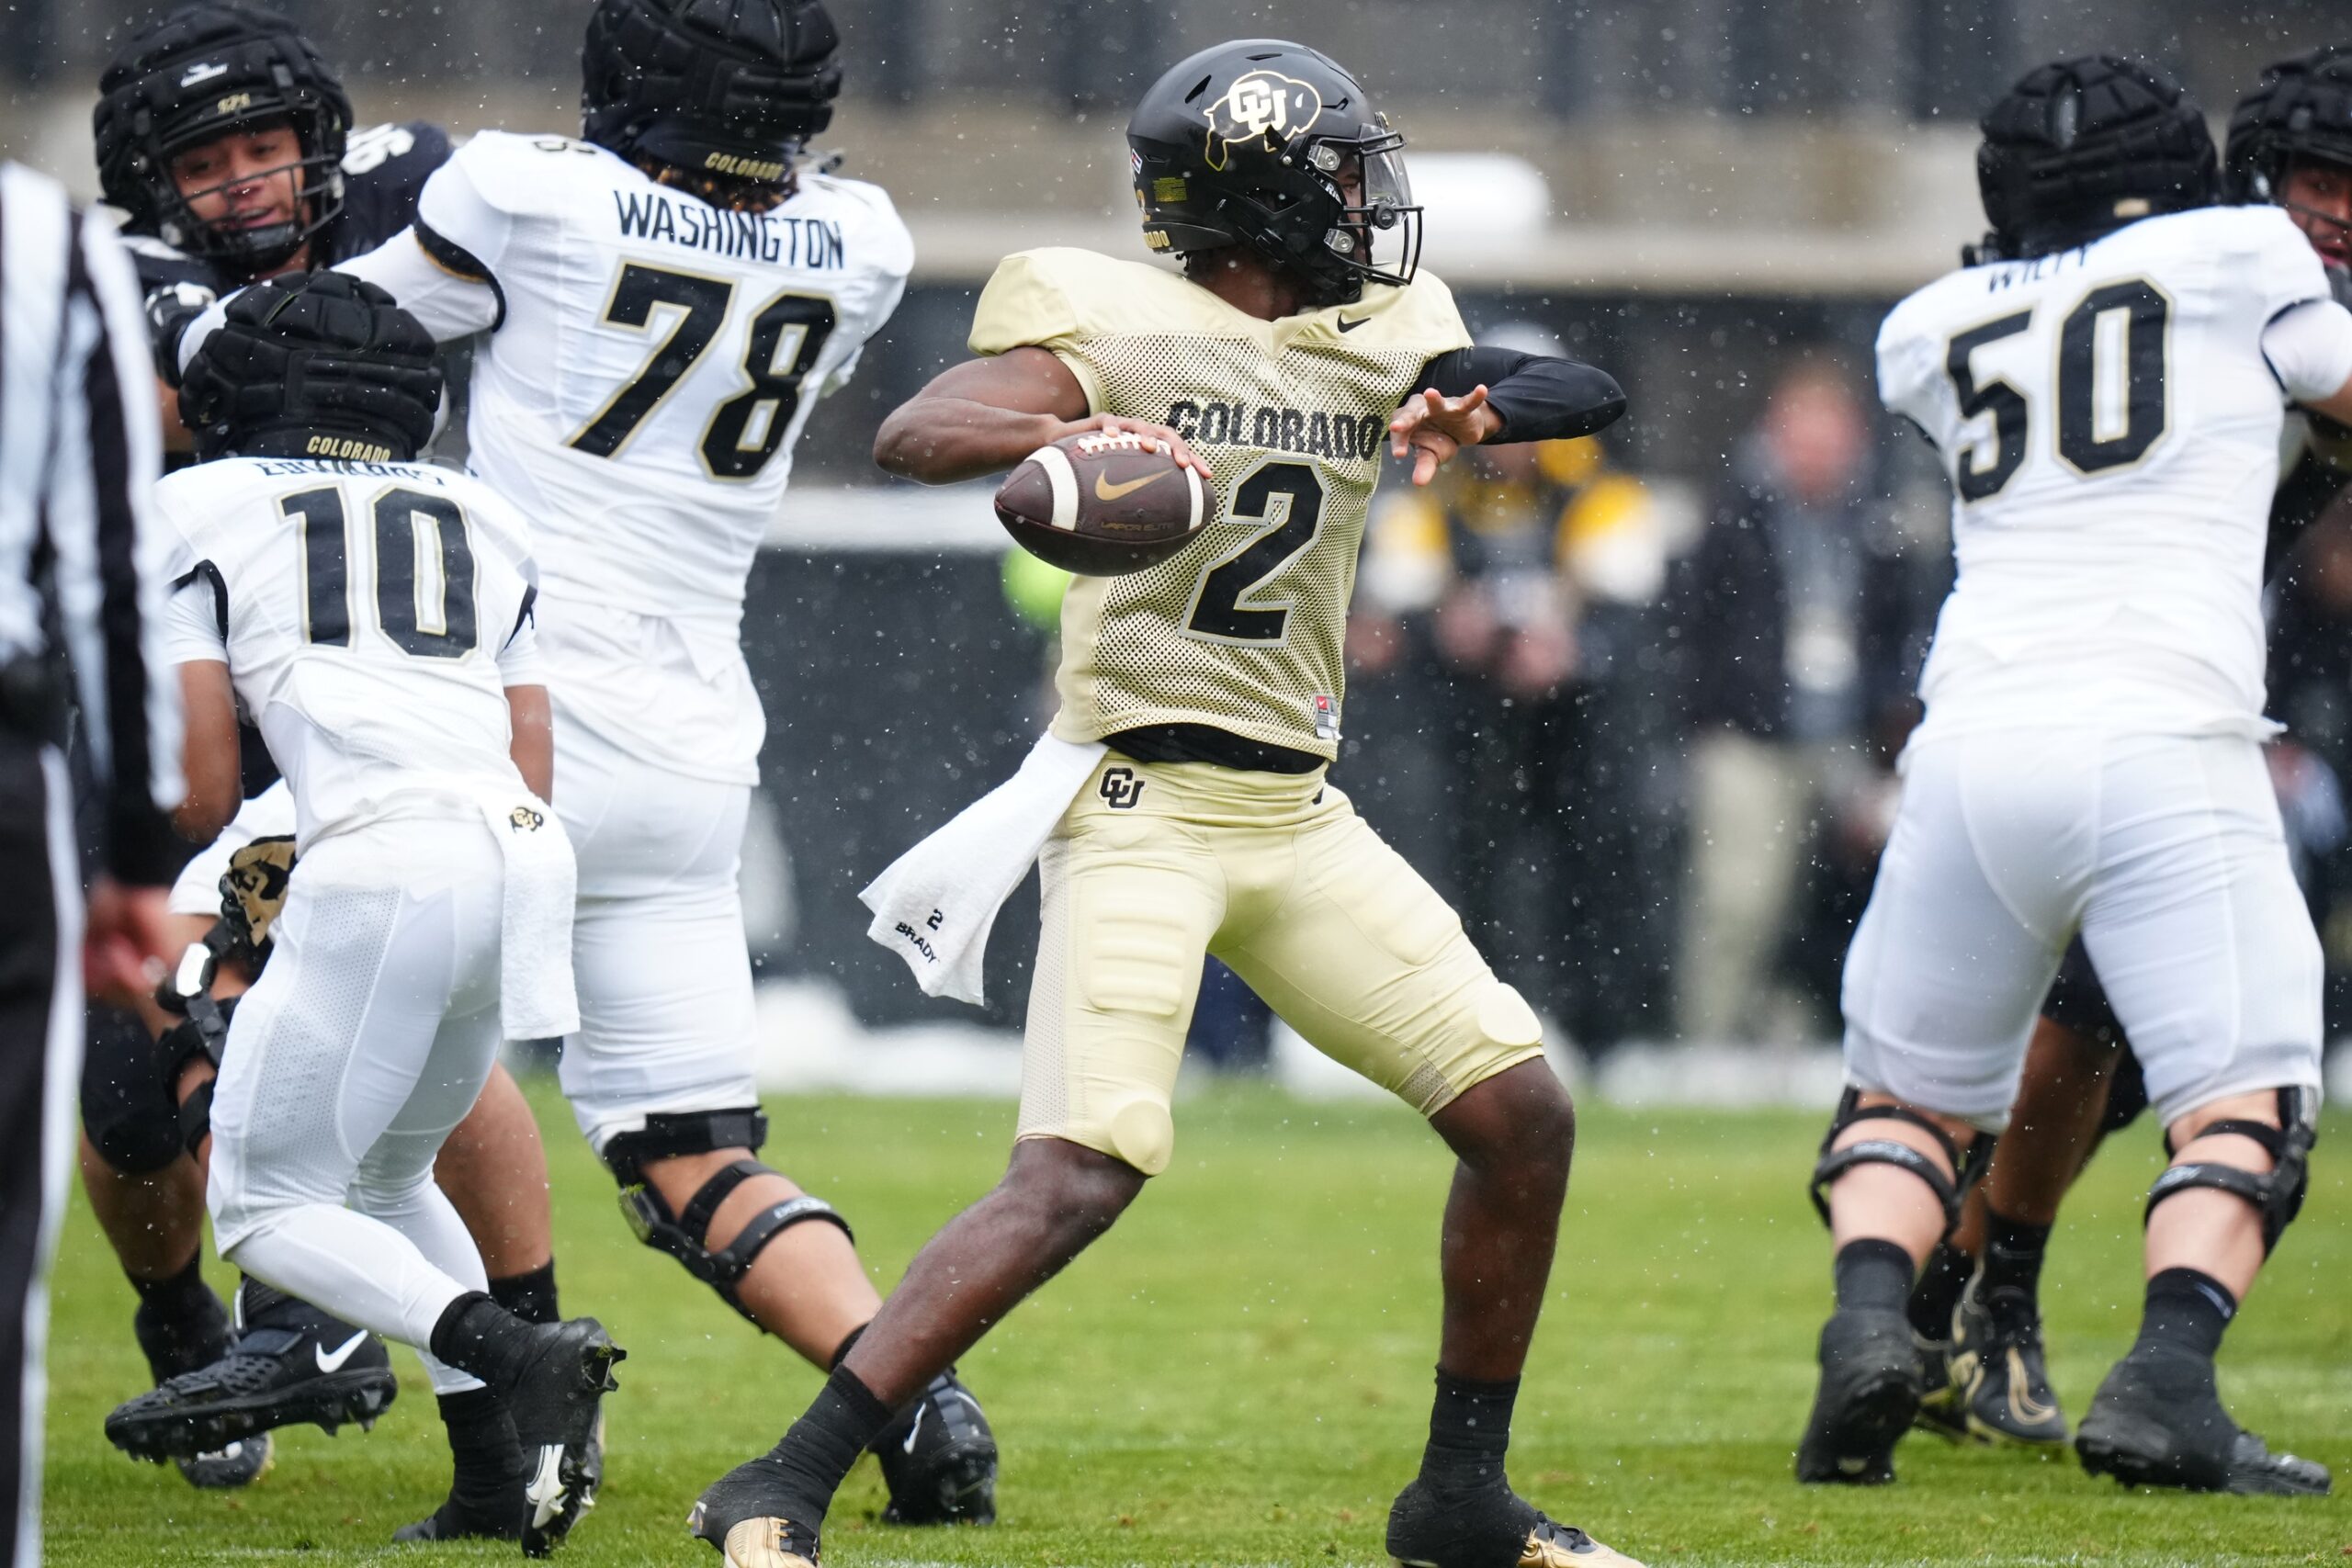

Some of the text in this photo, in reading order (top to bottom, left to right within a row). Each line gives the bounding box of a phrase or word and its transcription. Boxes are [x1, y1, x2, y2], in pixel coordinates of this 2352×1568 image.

[1228, 79, 1286, 133] CU
[705, 152, 784, 180] COLORADO
[614, 189, 843, 270] WASHINGTON
[561, 261, 839, 480] 78
[1946, 274, 2175, 507] 50
[306, 435, 391, 463] COLORADO
[1165, 400, 1385, 462] COLORADO
[273, 482, 481, 666] 10
[1177, 453, 1332, 649] 2
[1099, 766, 1146, 809] CU
[894, 921, 938, 964] BRADY
[926, 908, 943, 931] 2
